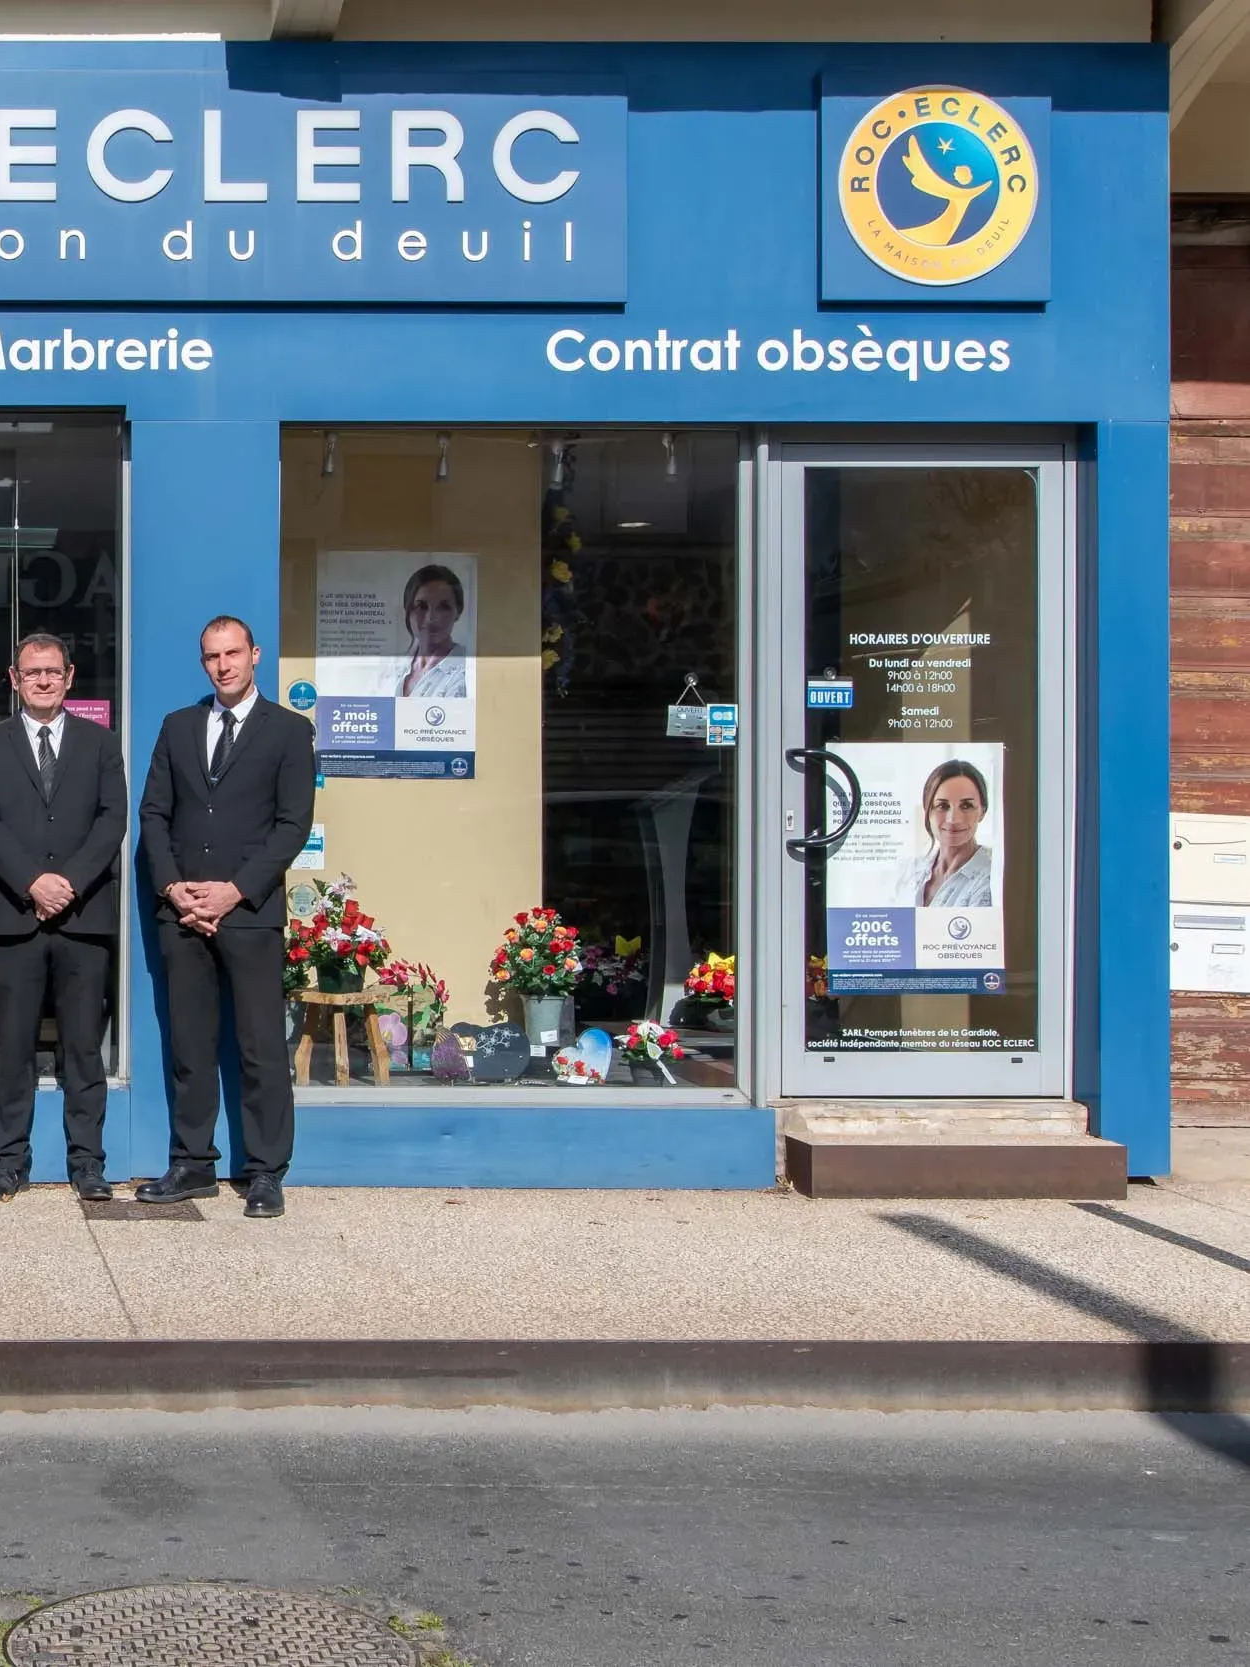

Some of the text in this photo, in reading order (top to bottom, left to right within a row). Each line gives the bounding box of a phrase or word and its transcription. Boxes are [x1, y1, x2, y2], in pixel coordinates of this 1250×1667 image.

[850, 96, 1027, 194] ROC ECLERC
[161, 220, 255, 261] du
[331, 220, 573, 262] deuil
[546, 324, 1012, 382] Contrat obsèques
[849, 633, 991, 645] HORAIRES D'OUVERTURE
[868, 658, 972, 668] Du lundi au vendredi
[887, 670, 953, 681] 9h00 à 12h00
[885, 682, 956, 693] 14h00 à 18h00
[810, 690, 851, 705] OUVERT
[332, 709, 378, 721] 2 mois
[901, 706, 940, 716] Samedi
[331, 720, 379, 733] offerts
[887, 718, 953, 729] 9h00 à 12h00
[851, 920, 892, 933] 200€
[844, 933, 899, 946] offerts
[922, 943, 941, 951] ROC
[842, 1028, 863, 1037] SARL
[864, 1028, 898, 1038] Pompes
[899, 1027, 936, 1037] funèbres
[937, 1028, 950, 1037] de
[950, 1028, 959, 1037] la
[807, 1038, 1035, 1049] société indépendante membre du réseau ROC ECLERC
